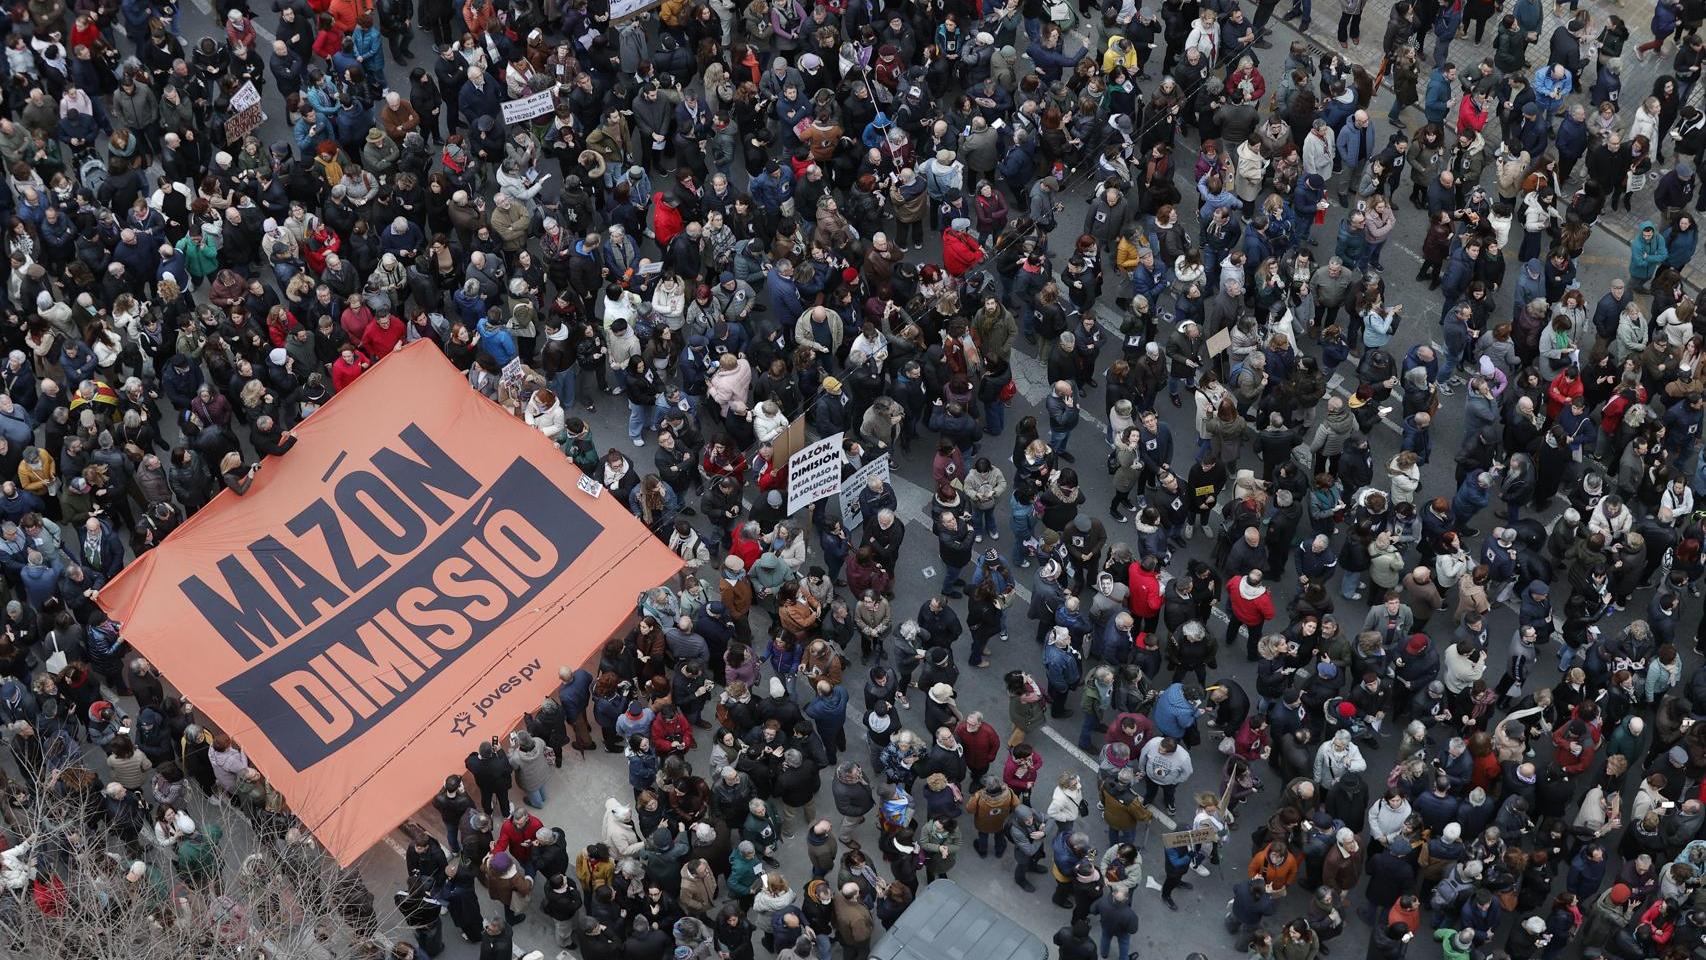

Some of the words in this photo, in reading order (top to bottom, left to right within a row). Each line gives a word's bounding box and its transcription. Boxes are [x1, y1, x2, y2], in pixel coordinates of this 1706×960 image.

[791, 442, 833, 468] MAZÓN,
[791, 450, 840, 481] DIMISIÓN
[790, 494, 799, 502] LA
[799, 474, 839, 495] SOLUCIÓN
[792, 476, 810, 491] DEJA
[811, 466, 832, 481] PASO
[178, 422, 483, 662] MAZÓN
[270, 497, 559, 745] DIMISSIÓ
[472, 675, 522, 718] joves
[518, 658, 541, 681] pv
